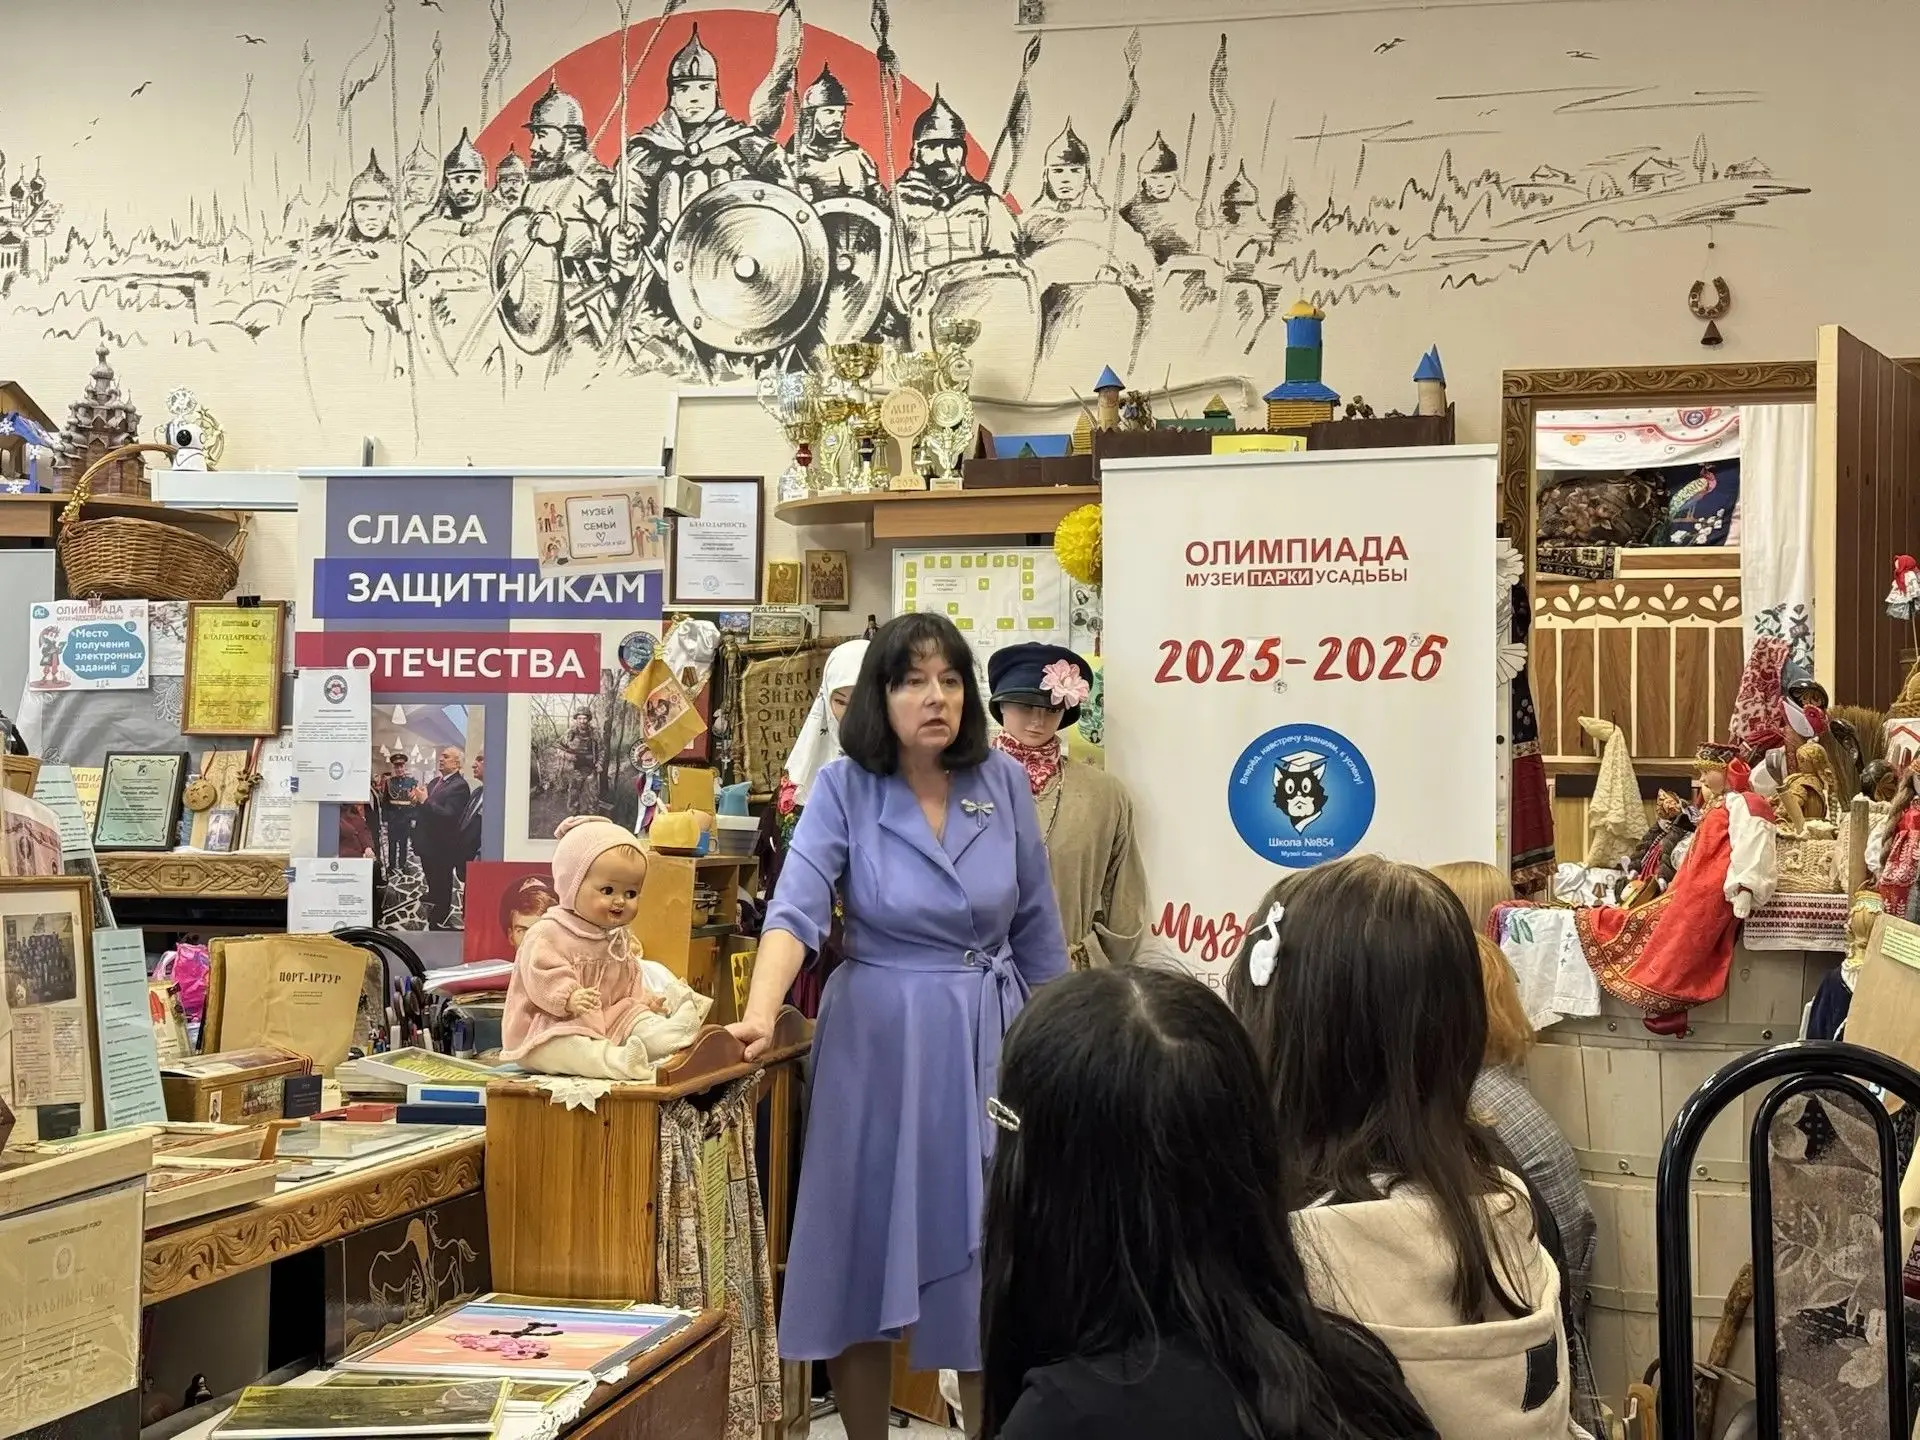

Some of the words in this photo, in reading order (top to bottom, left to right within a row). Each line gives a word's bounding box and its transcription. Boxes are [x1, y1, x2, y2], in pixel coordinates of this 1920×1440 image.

[581, 506, 614, 516] МУЗЕЙ
[347, 513, 488, 545] СЛАВА
[583, 521, 616, 531] СЕМЬИ
[689, 521, 748, 529] БЛАГОДАРНОСТЬ
[1185, 535, 1410, 567] ОЛИМПИАДА
[1186, 571, 1245, 588] МУЗЕИ
[1250, 568, 1312, 587] ПАРКИ
[1315, 567, 1409, 586] УСАДЬБЫ
[347, 572, 646, 608] ЗАЩИТНИКАМ
[57, 605, 124, 616] ОЛИМПИАДА
[75, 629, 109, 638] Место
[75, 641, 131, 651] получения
[74, 651, 143, 661] электронных
[74, 661, 117, 673] заданий
[346, 646, 586, 680] ОТЕЧЕСТВА
[1261, 735, 1302, 755] навстречу
[1268, 837, 1301, 848] Школа
[1304, 837, 1335, 848] №854
[279, 971, 342, 984] ПОРТ-АРТУР
